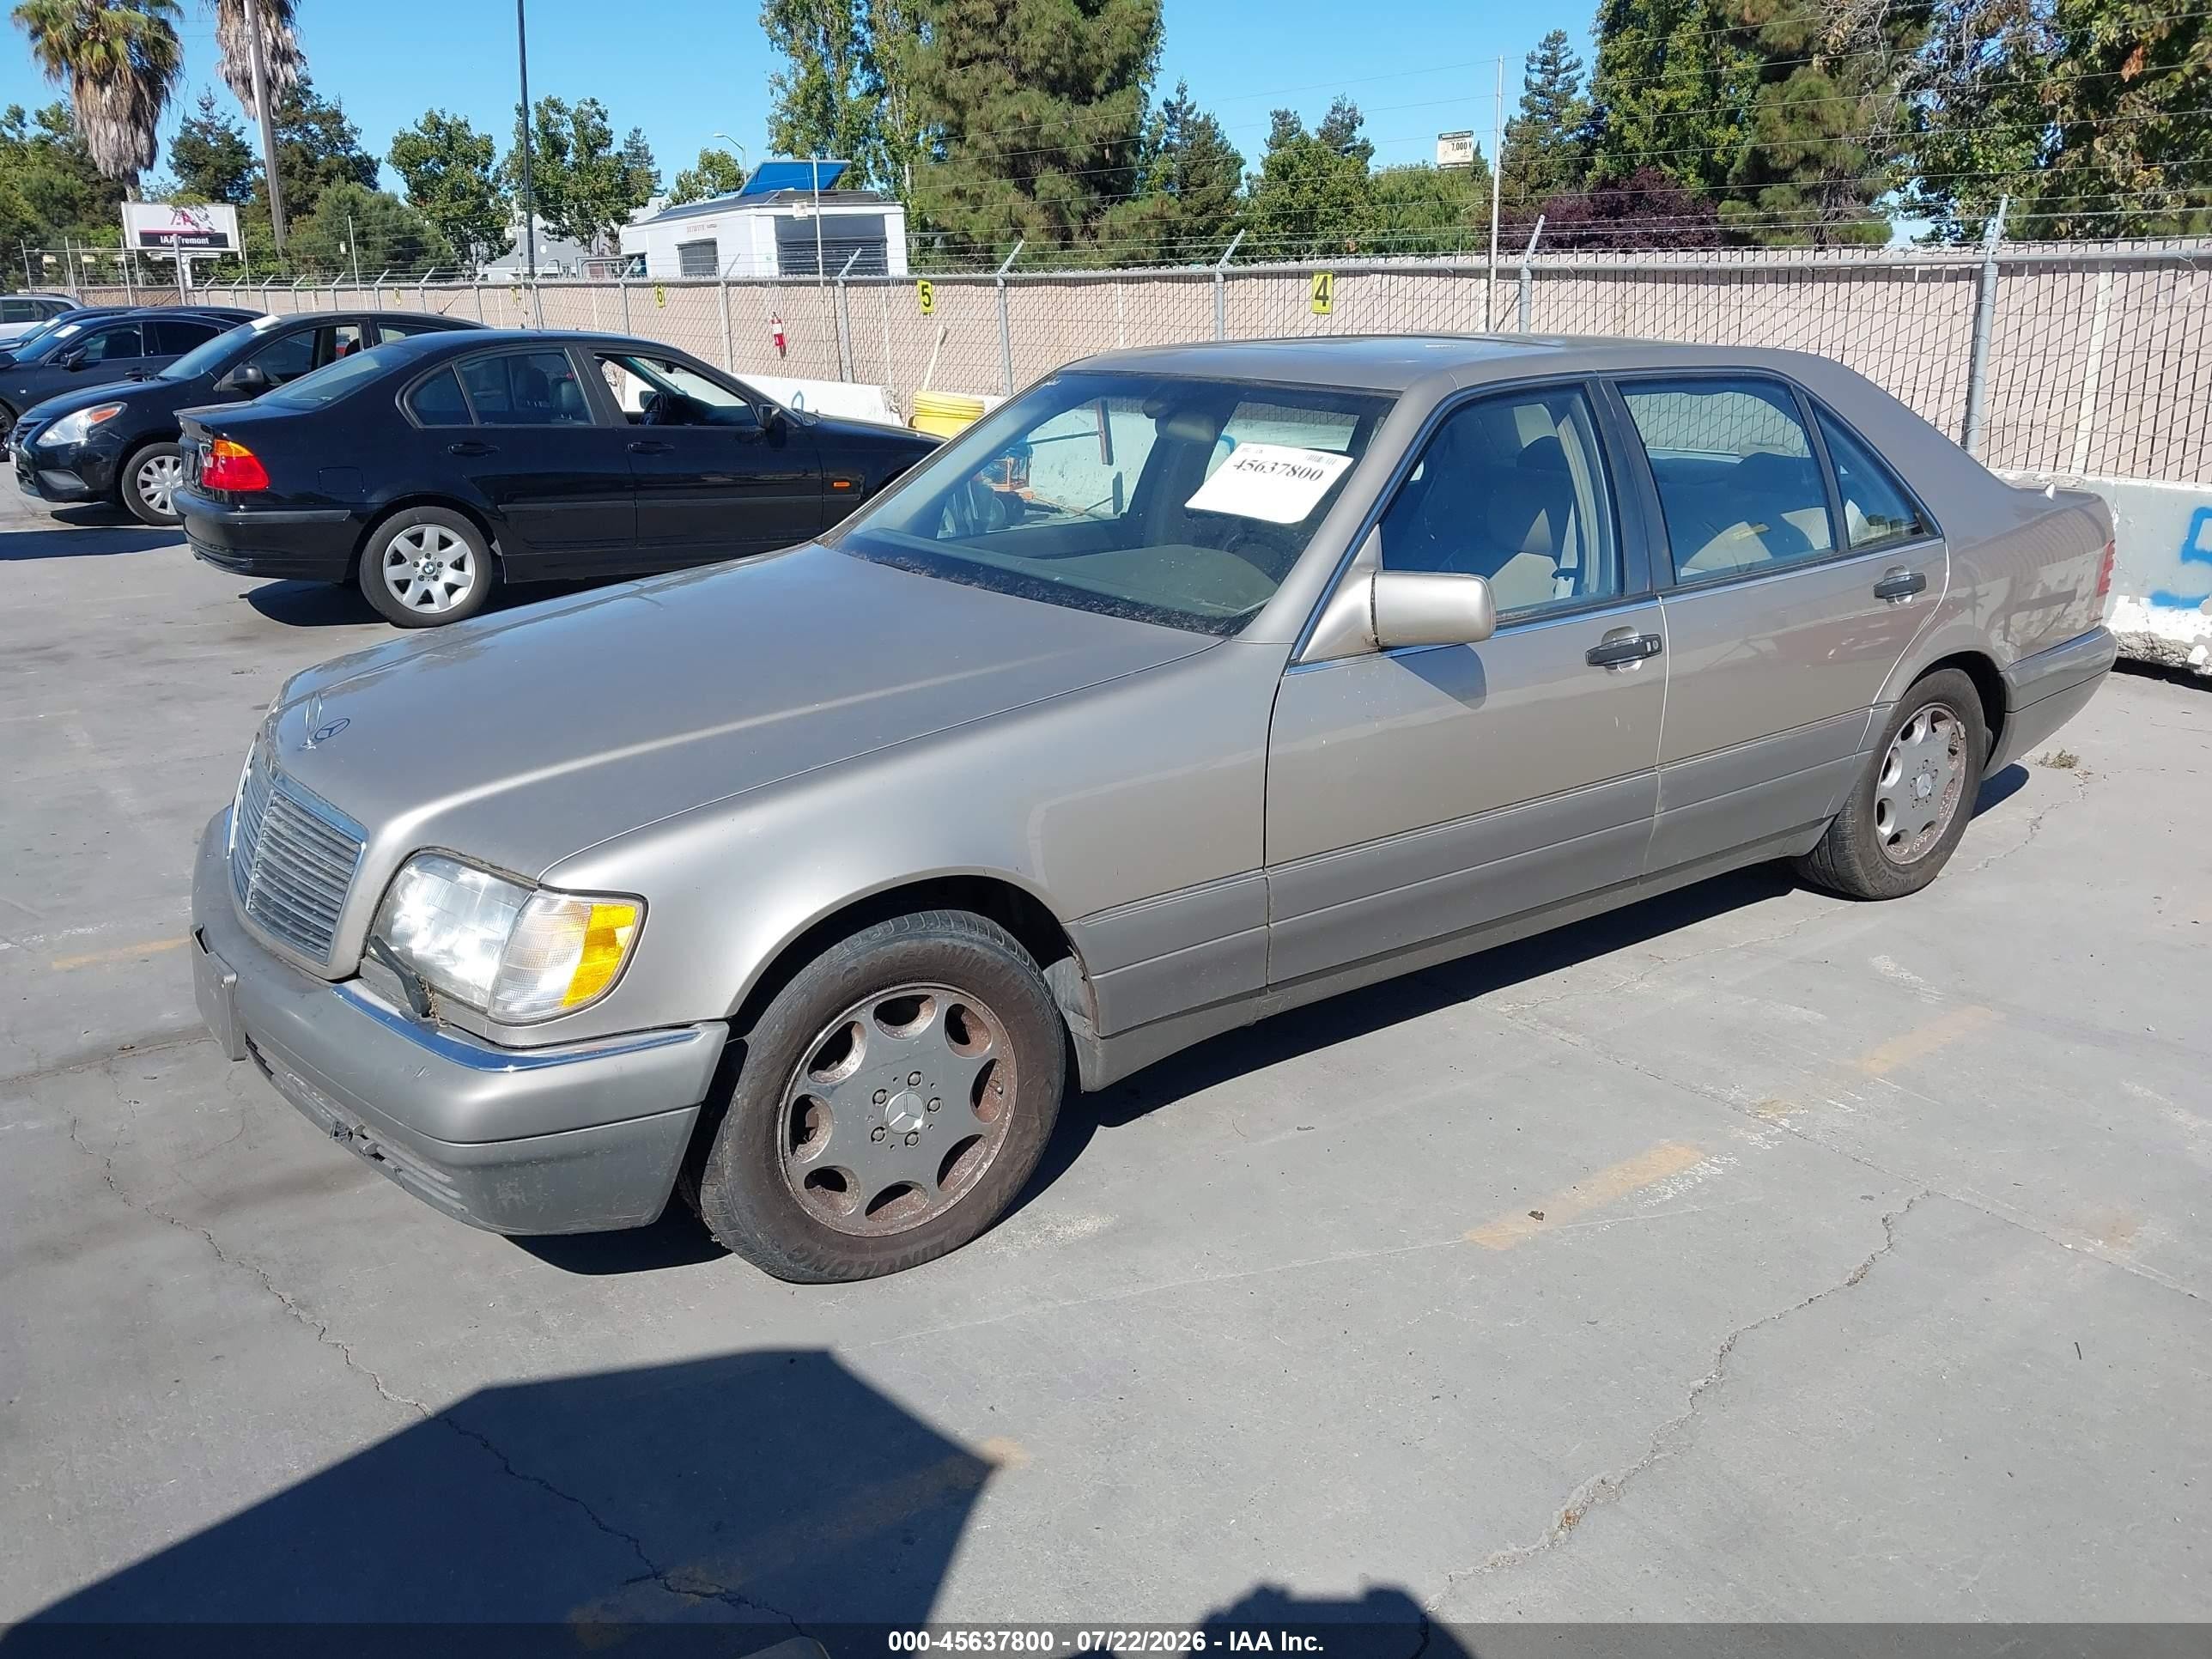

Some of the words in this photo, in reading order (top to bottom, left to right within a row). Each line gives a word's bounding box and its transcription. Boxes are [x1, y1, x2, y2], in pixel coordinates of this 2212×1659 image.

[160, 234, 174, 244] IAA
[657, 284, 663, 302] 6
[921, 284, 932, 307] 5
[1314, 276, 1329, 307] 4
[1232, 458, 1324, 482] 45637800
